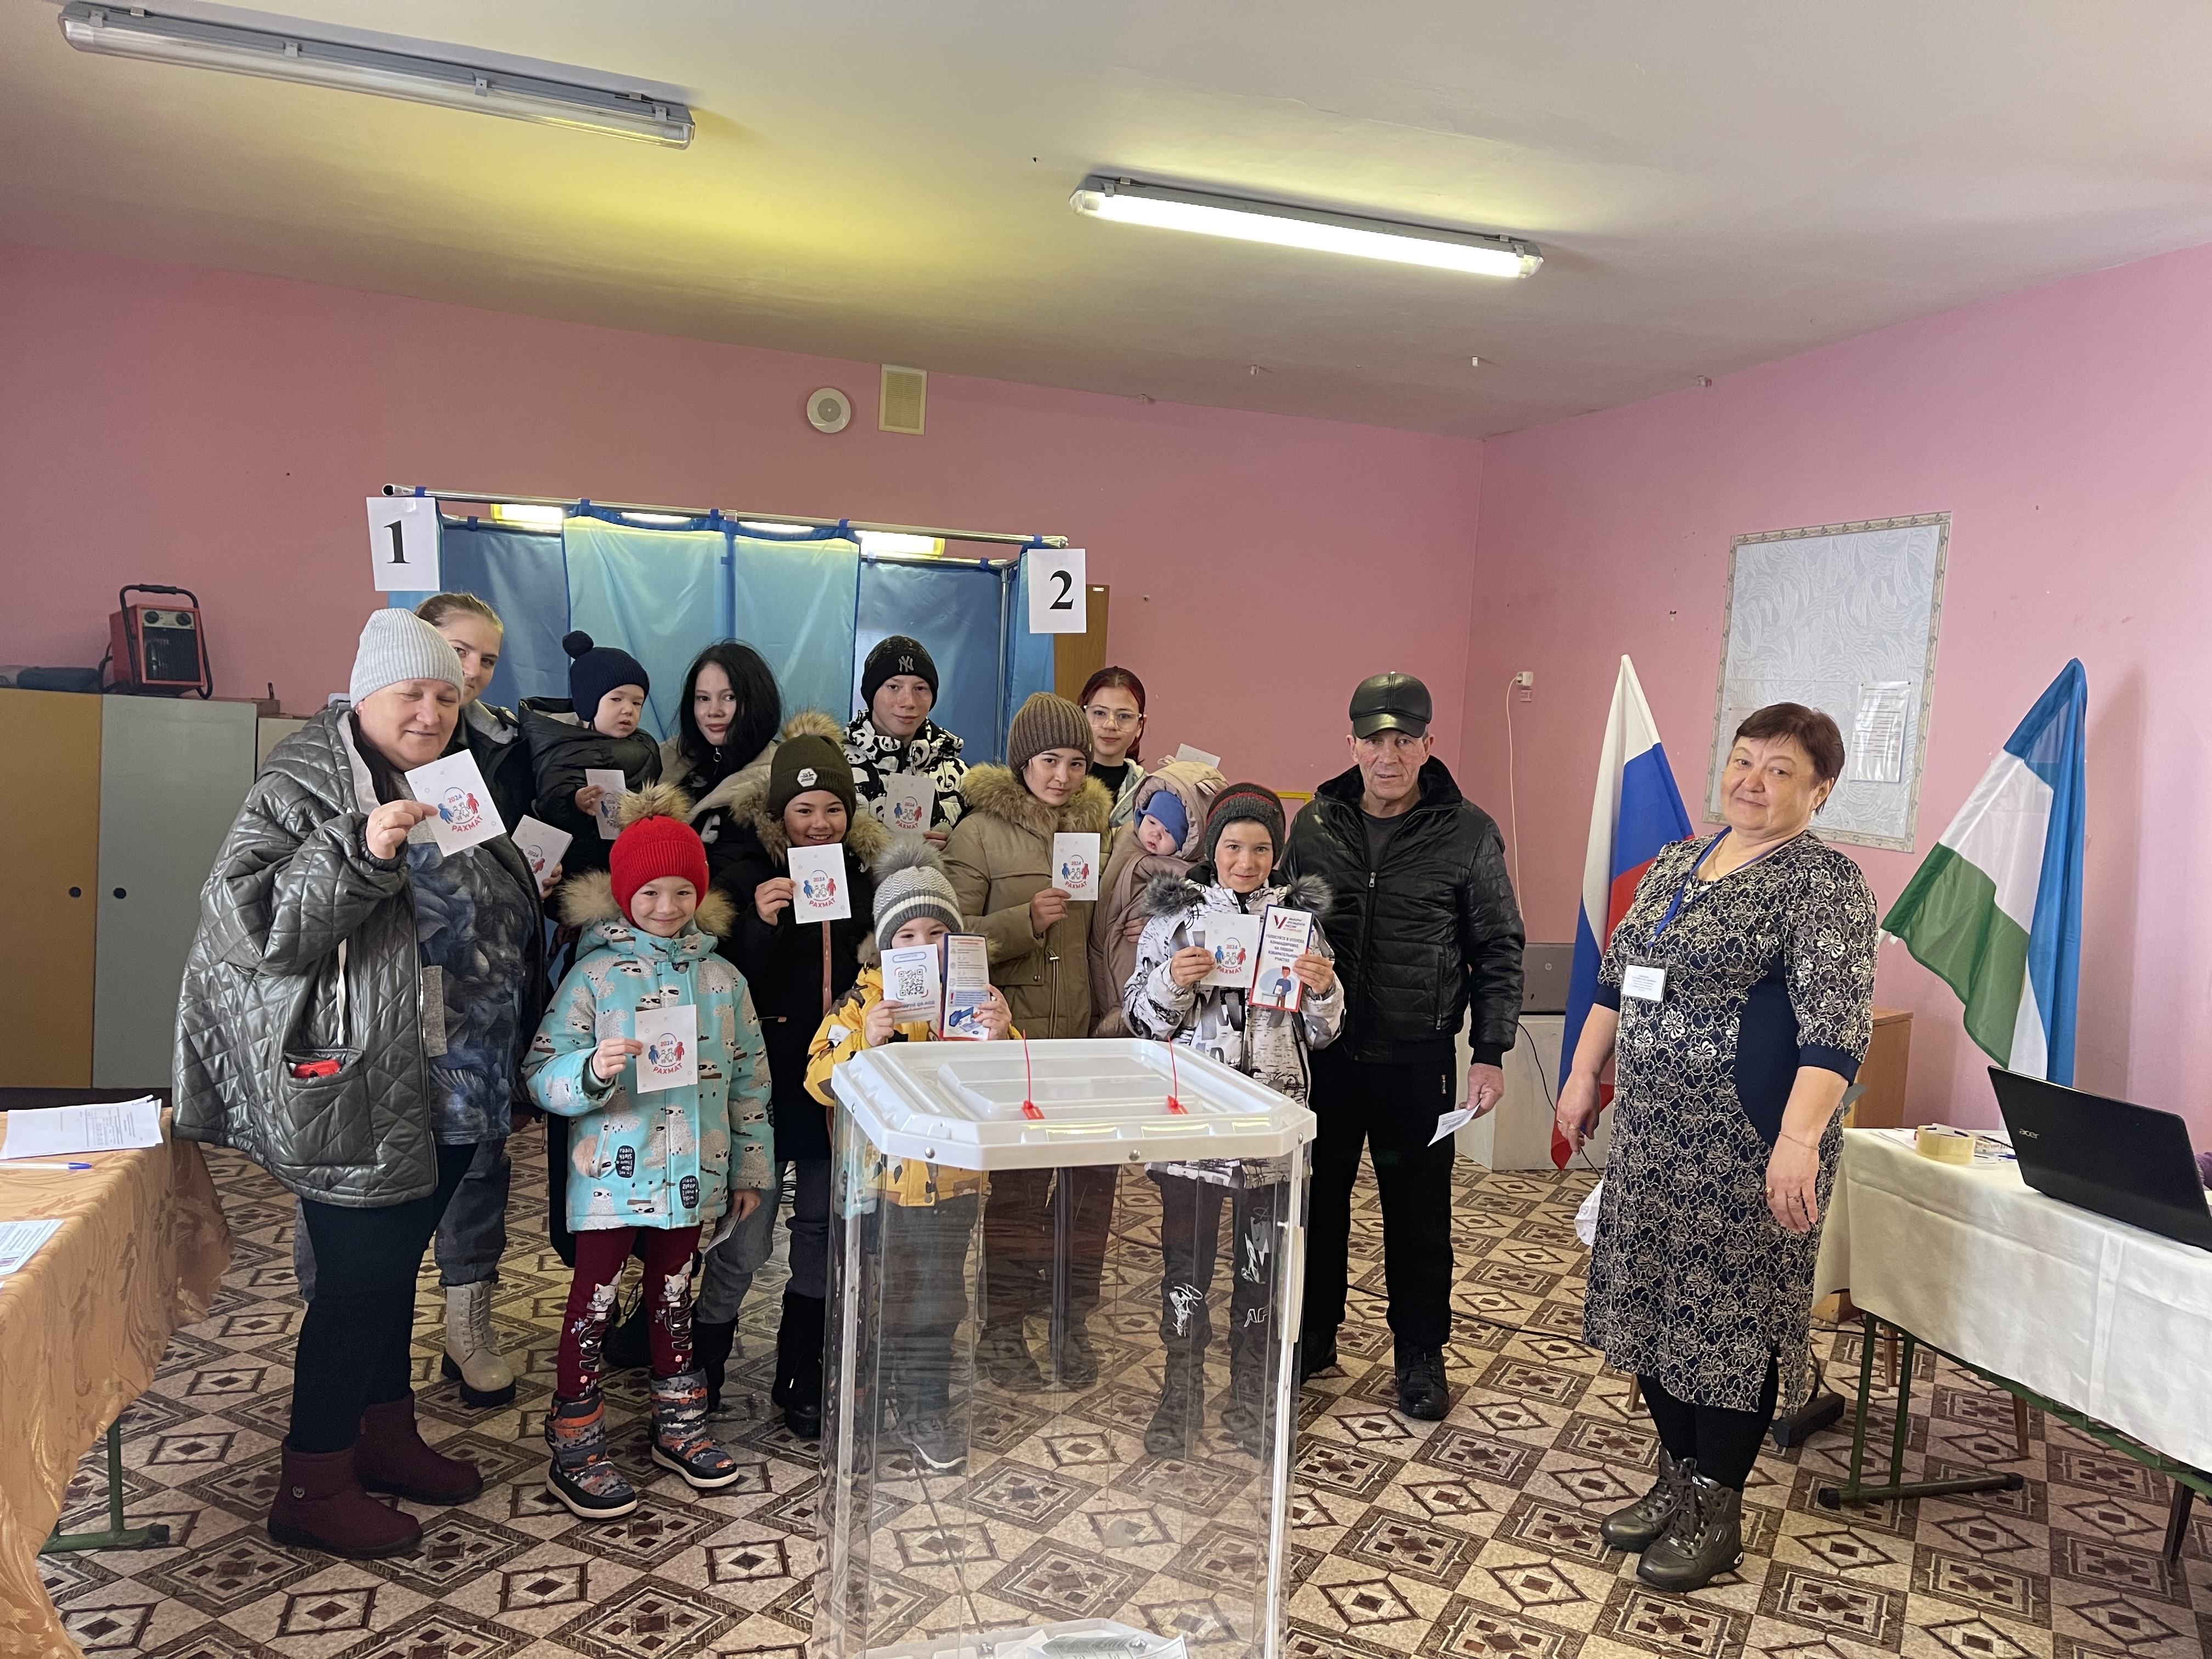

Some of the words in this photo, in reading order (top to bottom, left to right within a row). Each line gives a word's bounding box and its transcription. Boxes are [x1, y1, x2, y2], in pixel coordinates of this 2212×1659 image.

[383, 520, 410, 563] 1
[1049, 570, 1074, 610] 2
[898, 656, 914, 673] NY
[448, 794, 462, 803] 2024
[452, 815, 483, 832] РАХМАТ
[895, 820, 918, 830] РАХМАТ
[1064, 881, 1087, 889] РАХМАТ
[809, 898, 836, 908] РАХМАТ
[1216, 966, 1242, 974] РАХМАТ
[653, 1062, 682, 1074] РАХМАТ
[2019, 1128, 2040, 1139] acer
